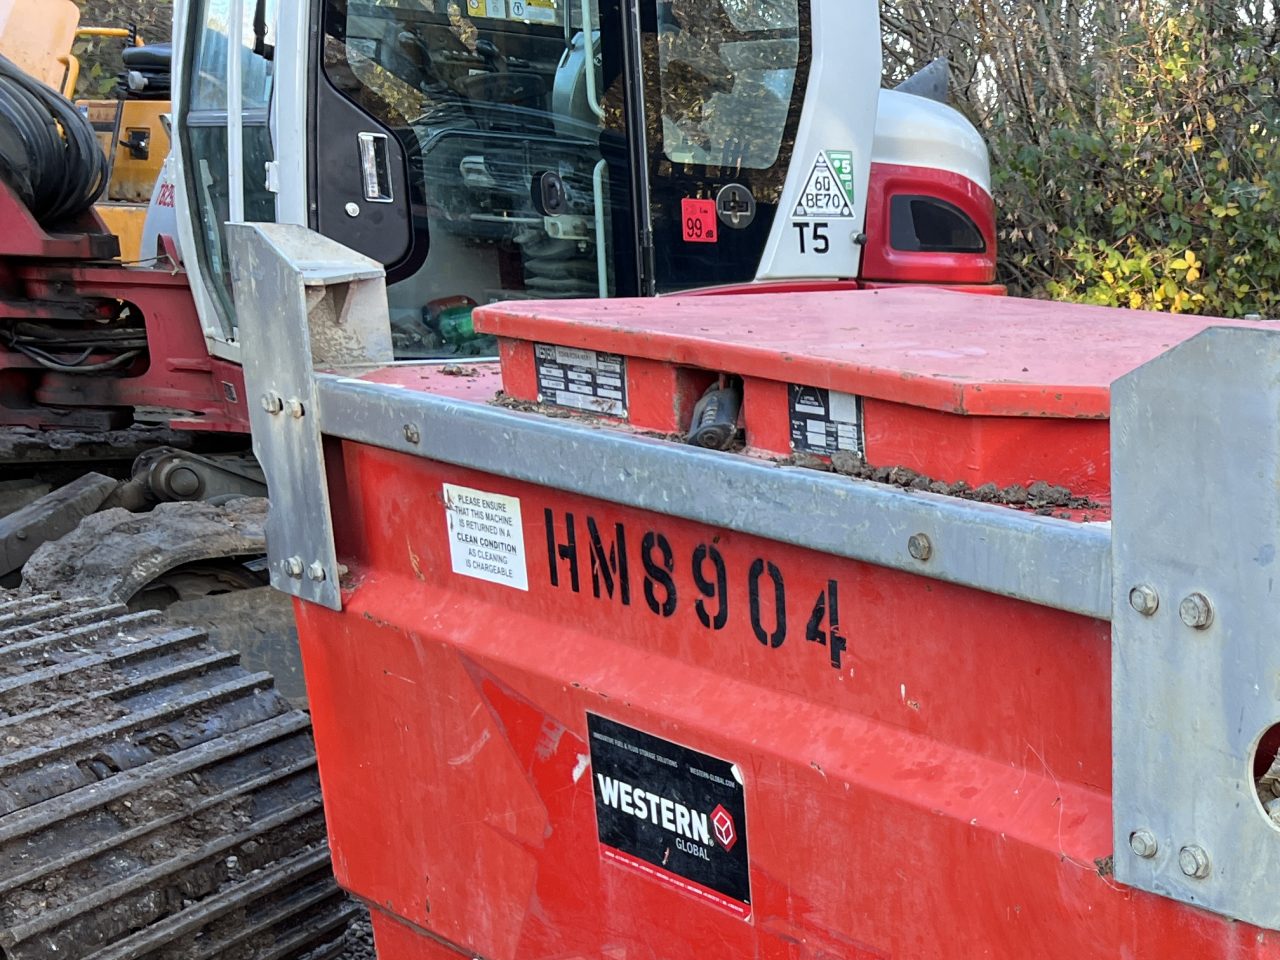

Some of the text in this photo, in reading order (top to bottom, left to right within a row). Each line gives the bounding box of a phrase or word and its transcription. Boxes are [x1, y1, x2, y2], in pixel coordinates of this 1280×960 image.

[805, 193, 840, 209] BE70
[686, 217, 702, 238] 99
[792, 222, 830, 254] T5
[457, 494, 507, 513] PLEASE ENSURE
[454, 505, 513, 527] THAT THIS MACHINE
[458, 518, 511, 538] IS RETURNED IN A
[456, 532, 517, 553] CLEAN CONDITION
[465, 558, 472, 568] IS
[468, 548, 508, 565] AS CLEANING
[597, 773, 711, 846] WESTERN
[675, 837, 711, 861] GLOBAL
